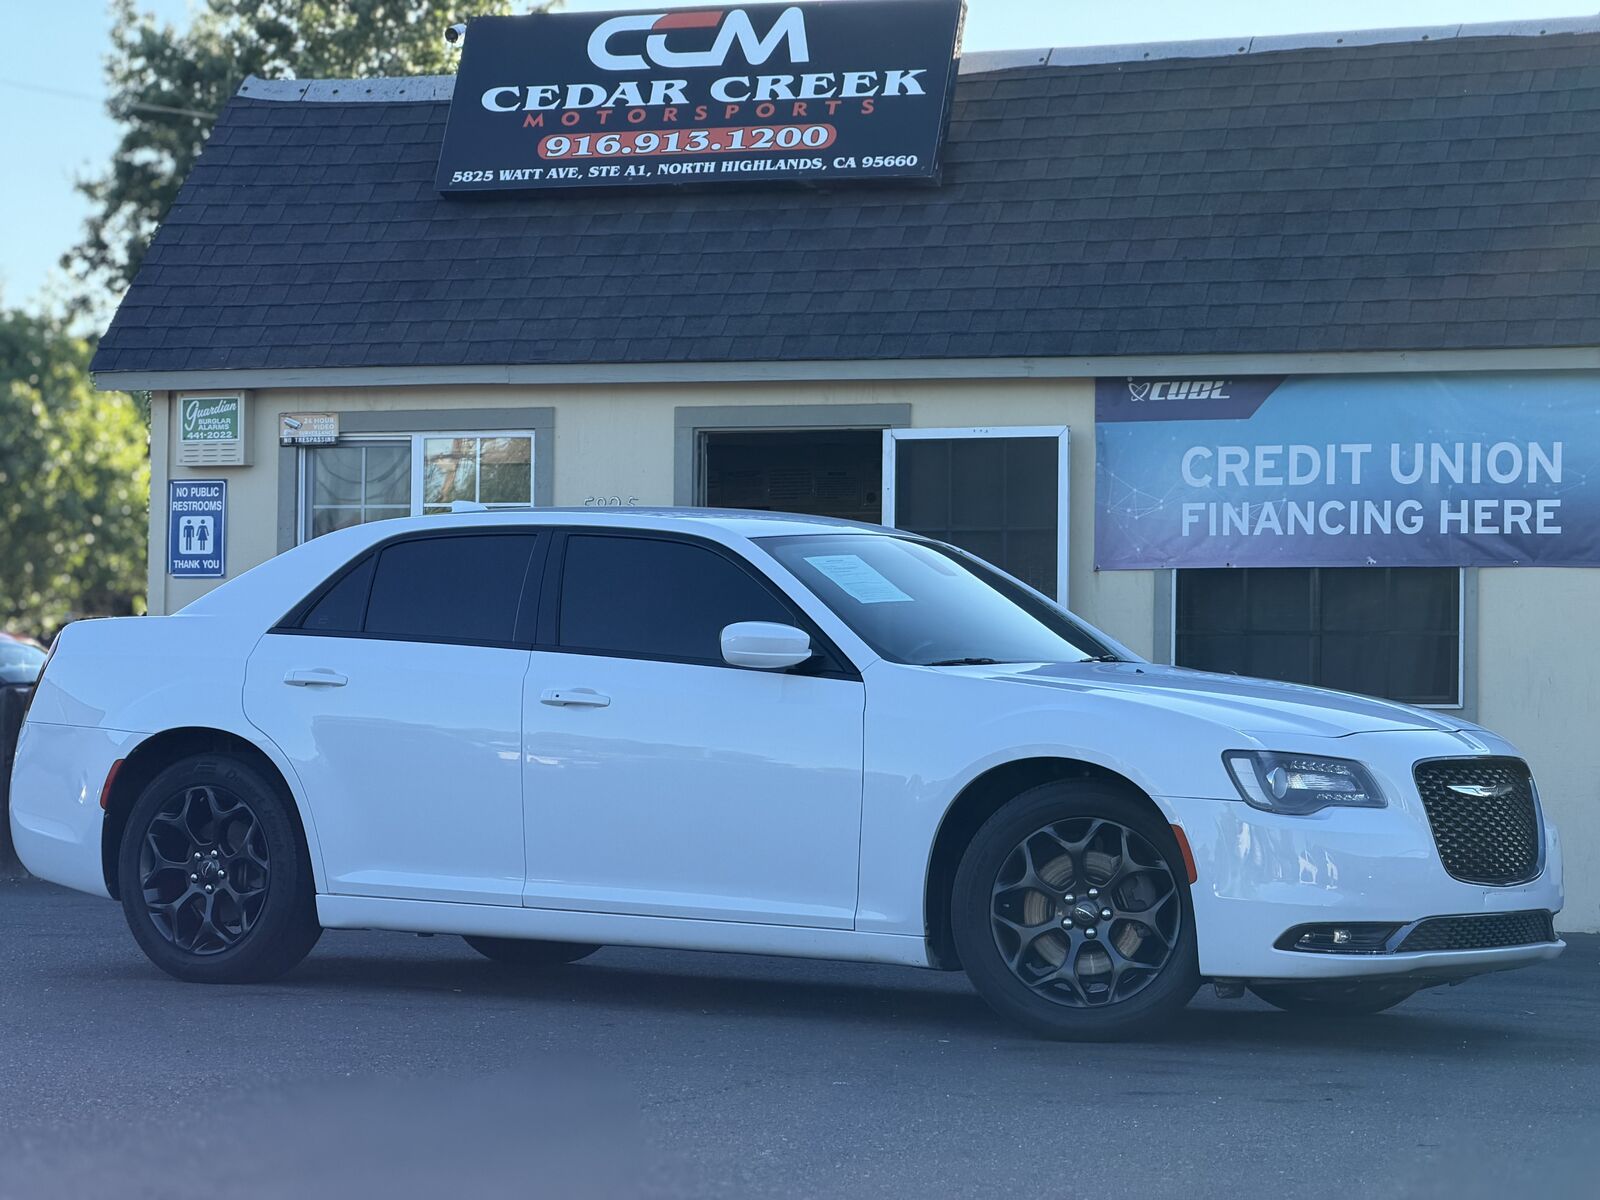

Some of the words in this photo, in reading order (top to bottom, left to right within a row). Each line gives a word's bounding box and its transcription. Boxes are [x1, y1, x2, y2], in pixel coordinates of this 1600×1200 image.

[587, 6, 810, 71] CCM
[481, 79, 690, 112] CEDAR
[710, 69, 927, 102] CREEK
[523, 99, 875, 128] MOTORSPORTS
[545, 125, 830, 157] 916.913.1200
[452, 170, 494, 182] 5825
[499, 168, 543, 180] WATT
[546, 166, 583, 179] AVE,
[588, 165, 620, 178] STE
[626, 164, 651, 177] A1,
[657, 160, 715, 175] NORTH
[721, 157, 827, 172] HIGHLANDS,
[833, 156, 857, 168] CA
[862, 155, 918, 168] 95660
[184, 399, 237, 431] Guardian
[198, 417, 231, 425] BURGLAR
[198, 423, 230, 431] ALARMS
[1181, 444, 1372, 488] CREDIT
[1390, 441, 1563, 484] UNION
[172, 501, 222, 511] RESTROOMS
[176, 487, 188, 498] NO
[190, 486, 220, 498] PUBLIC
[1181, 500, 1424, 537] FINANCING
[1439, 499, 1562, 535] HERE
[173, 559, 200, 569] THANK
[202, 559, 220, 569] YOU
